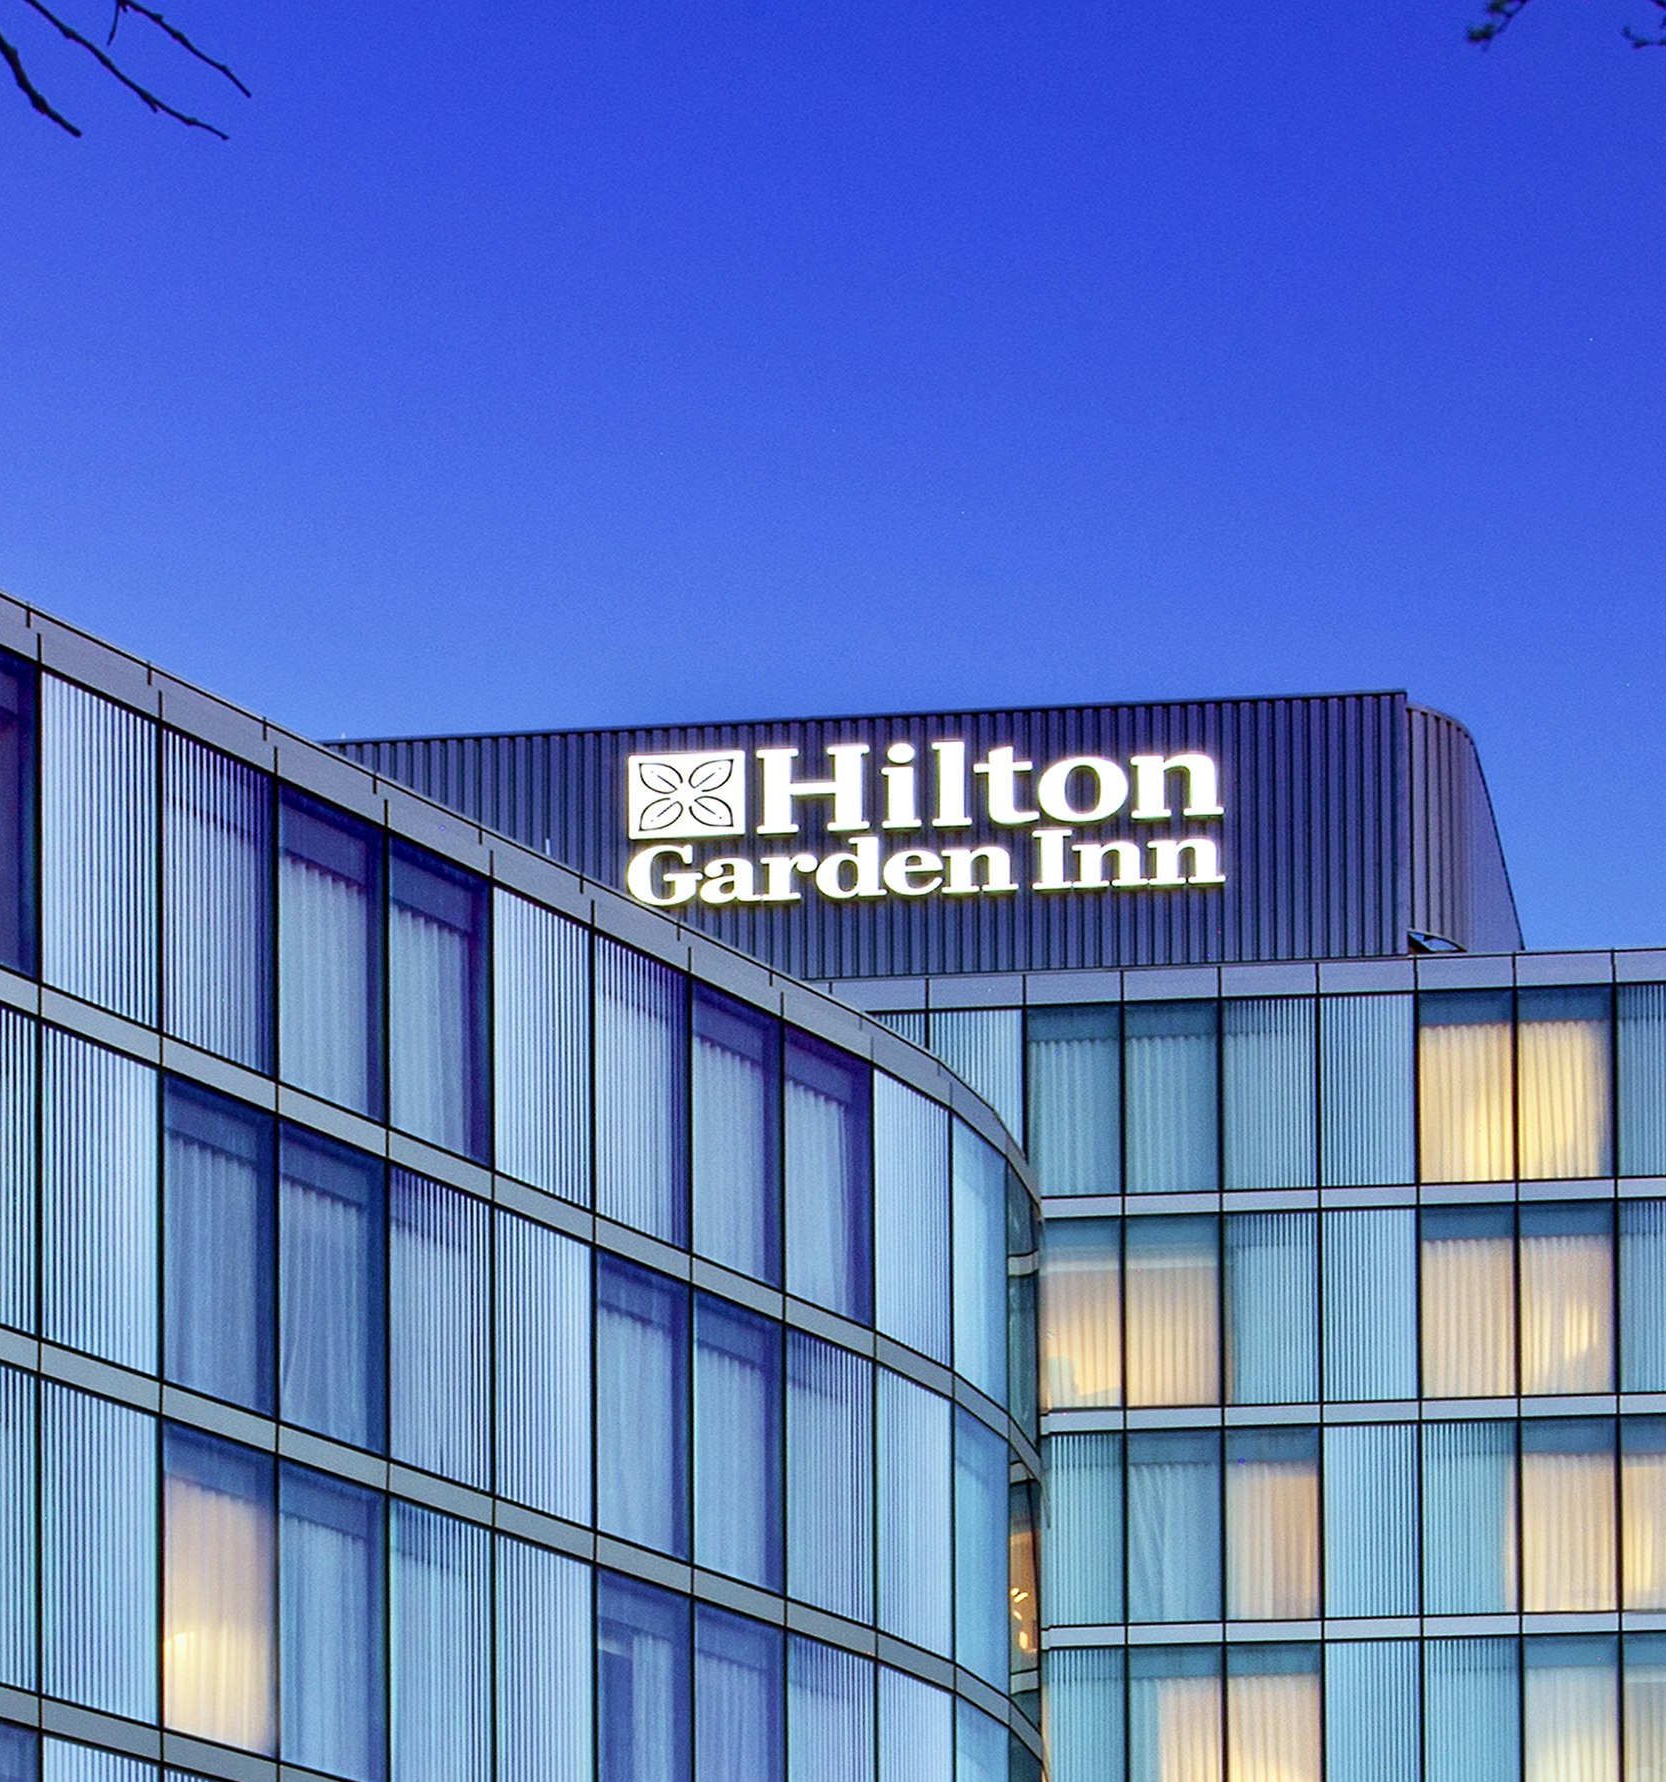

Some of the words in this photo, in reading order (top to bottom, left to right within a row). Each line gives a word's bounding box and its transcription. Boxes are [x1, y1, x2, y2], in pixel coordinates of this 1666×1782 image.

[756, 741, 1225, 835] Hilton
[627, 835, 1019, 908] Garden
[1032, 828, 1226, 891] Inn
